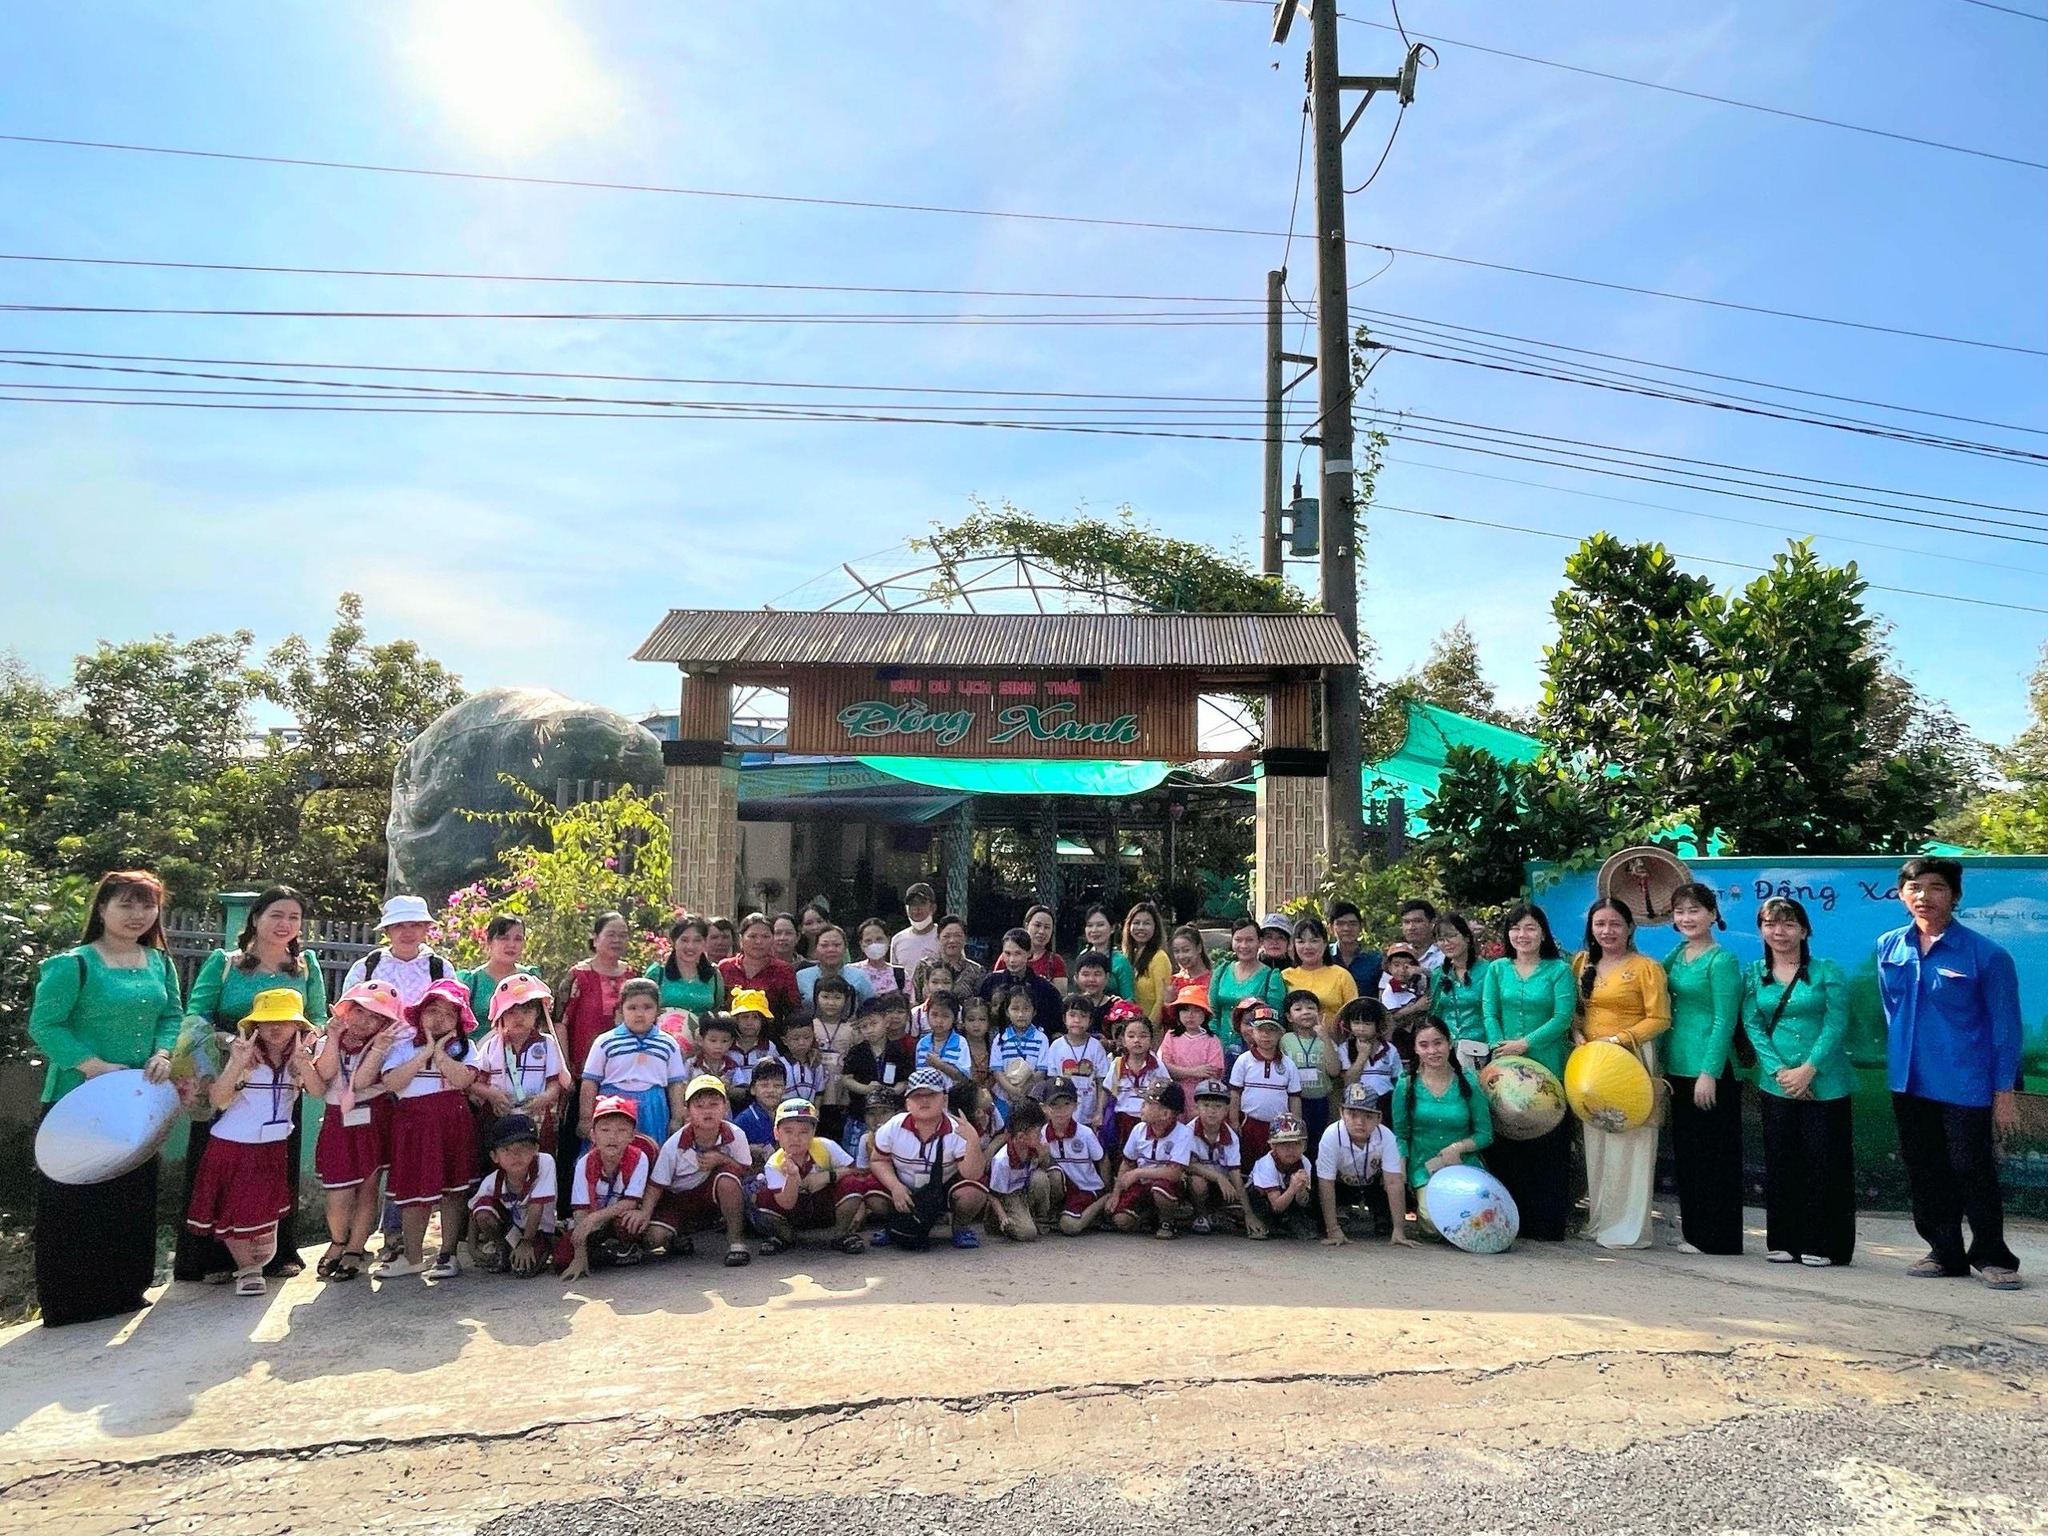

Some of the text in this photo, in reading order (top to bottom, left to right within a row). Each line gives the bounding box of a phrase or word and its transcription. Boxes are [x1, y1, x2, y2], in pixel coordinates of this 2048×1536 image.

[928, 680, 950, 693] DU
[998, 681, 1036, 695] SINH
[1044, 679, 1080, 695] THÁI
[987, 702, 1140, 744] Xanh
[1858, 881, 1900, 900] Xa
